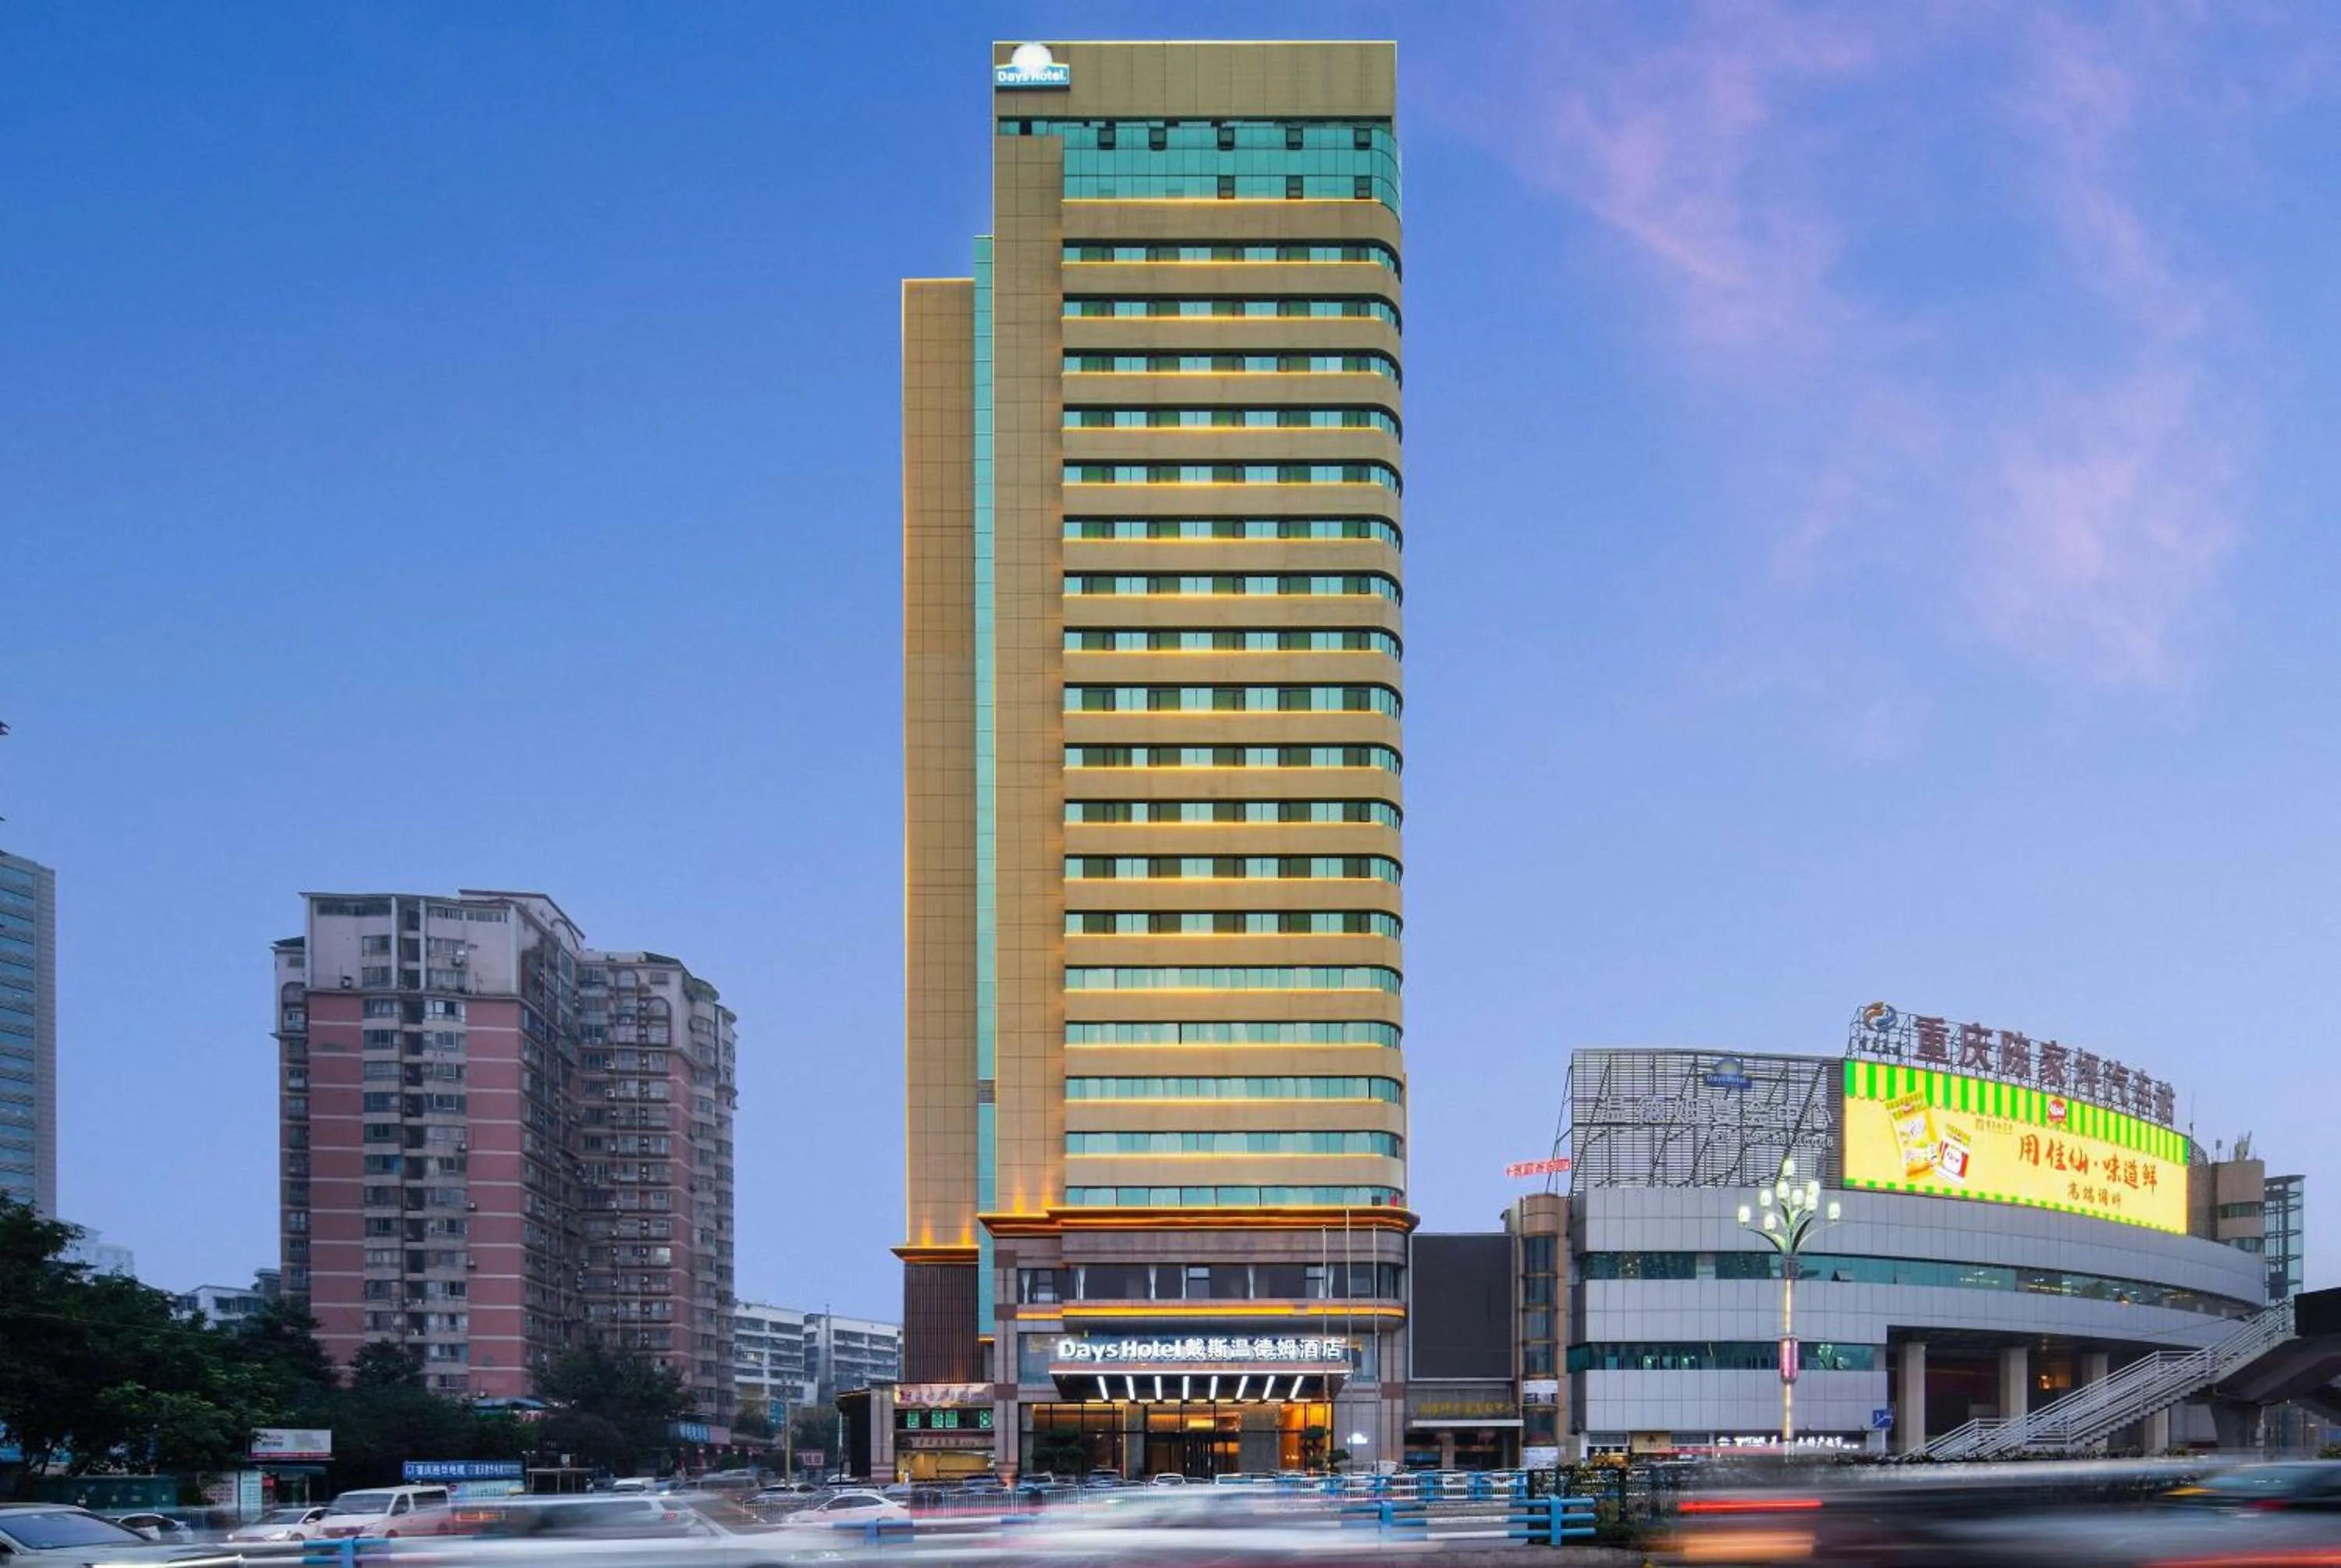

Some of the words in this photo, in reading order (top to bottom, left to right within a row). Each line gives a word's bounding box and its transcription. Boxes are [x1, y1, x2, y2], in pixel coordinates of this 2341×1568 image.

[997, 71, 1028, 83] Days
[1598, 1095, 1833, 1130] 温德姆宴会中心
[1058, 1339, 1118, 1362] Days
[1121, 1339, 1181, 1358] Hotel
[1185, 1338, 1341, 1360] 戴斯温德姆酒店
